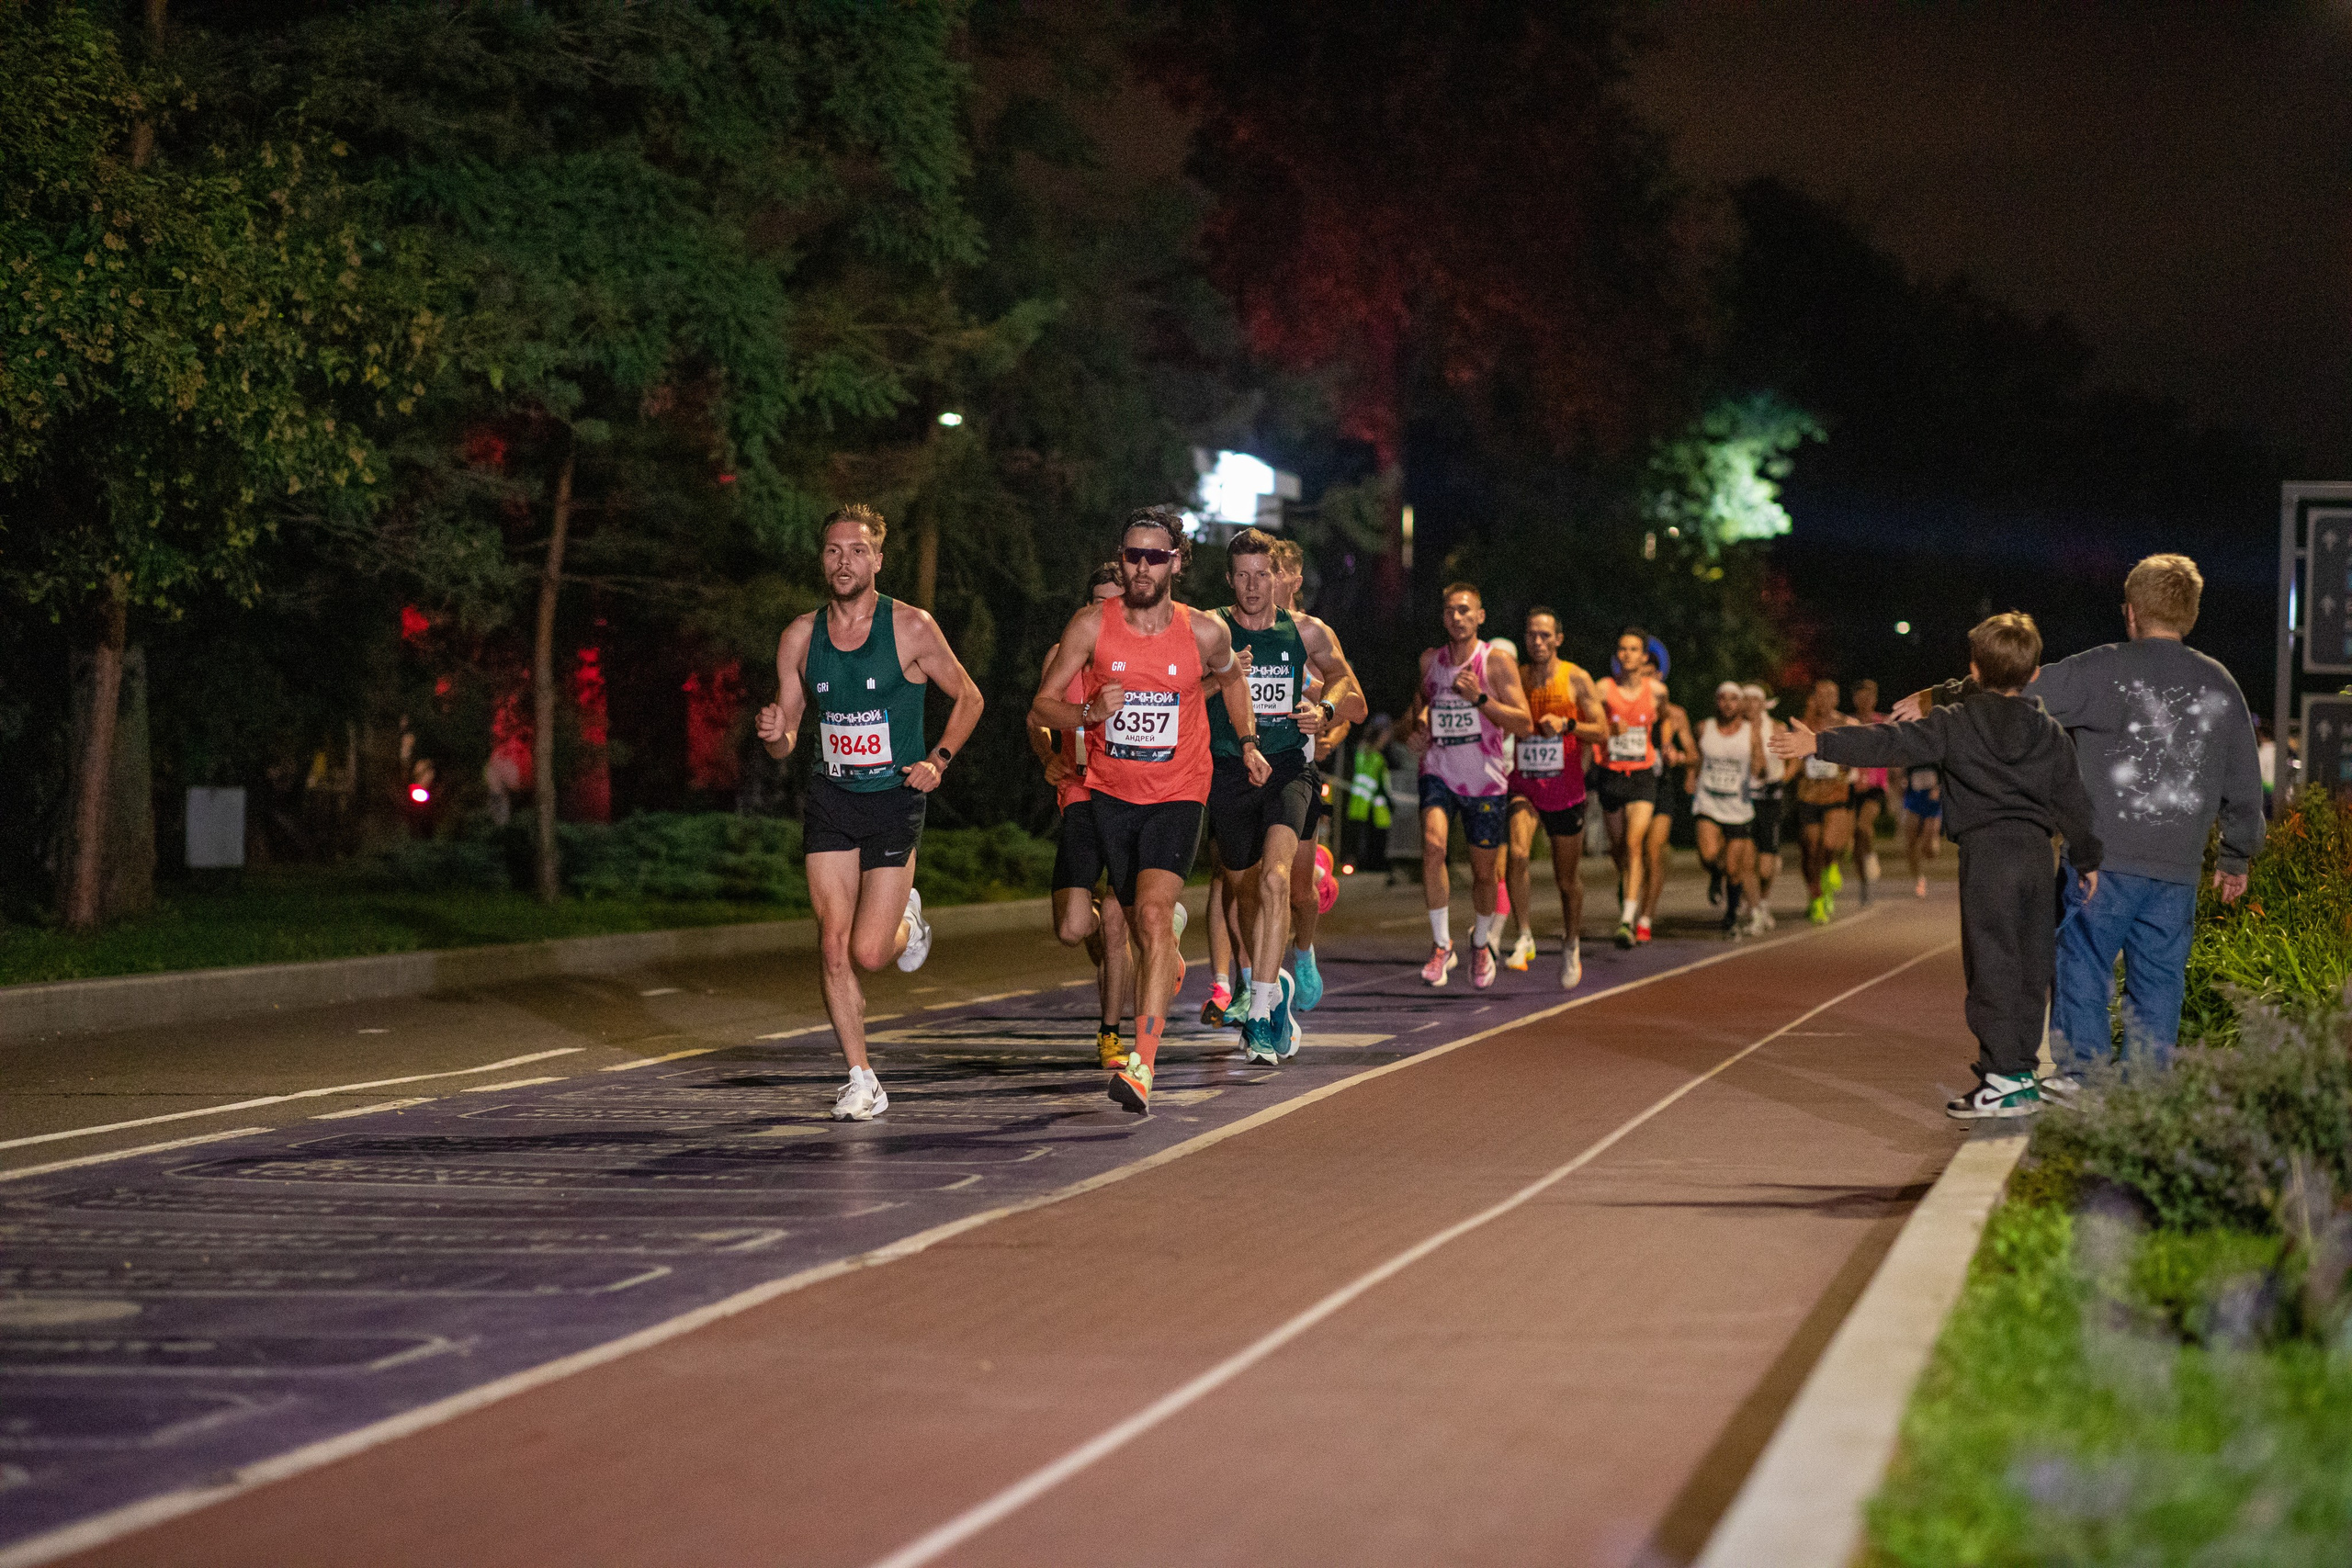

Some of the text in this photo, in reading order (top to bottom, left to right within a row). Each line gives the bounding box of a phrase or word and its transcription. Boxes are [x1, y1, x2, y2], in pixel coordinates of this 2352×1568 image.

[1250, 665, 1289, 675] ОЧНОЙ
[1124, 691, 1174, 704] ОЧНОЙ
[1250, 682, 1285, 702] 305
[1113, 711, 1170, 733] 6357
[1438, 712, 1473, 728] 3725
[829, 733, 881, 755] 9848
[1125, 734, 1155, 743] АНДРЕЙ
[1523, 747, 1557, 761] 4192
